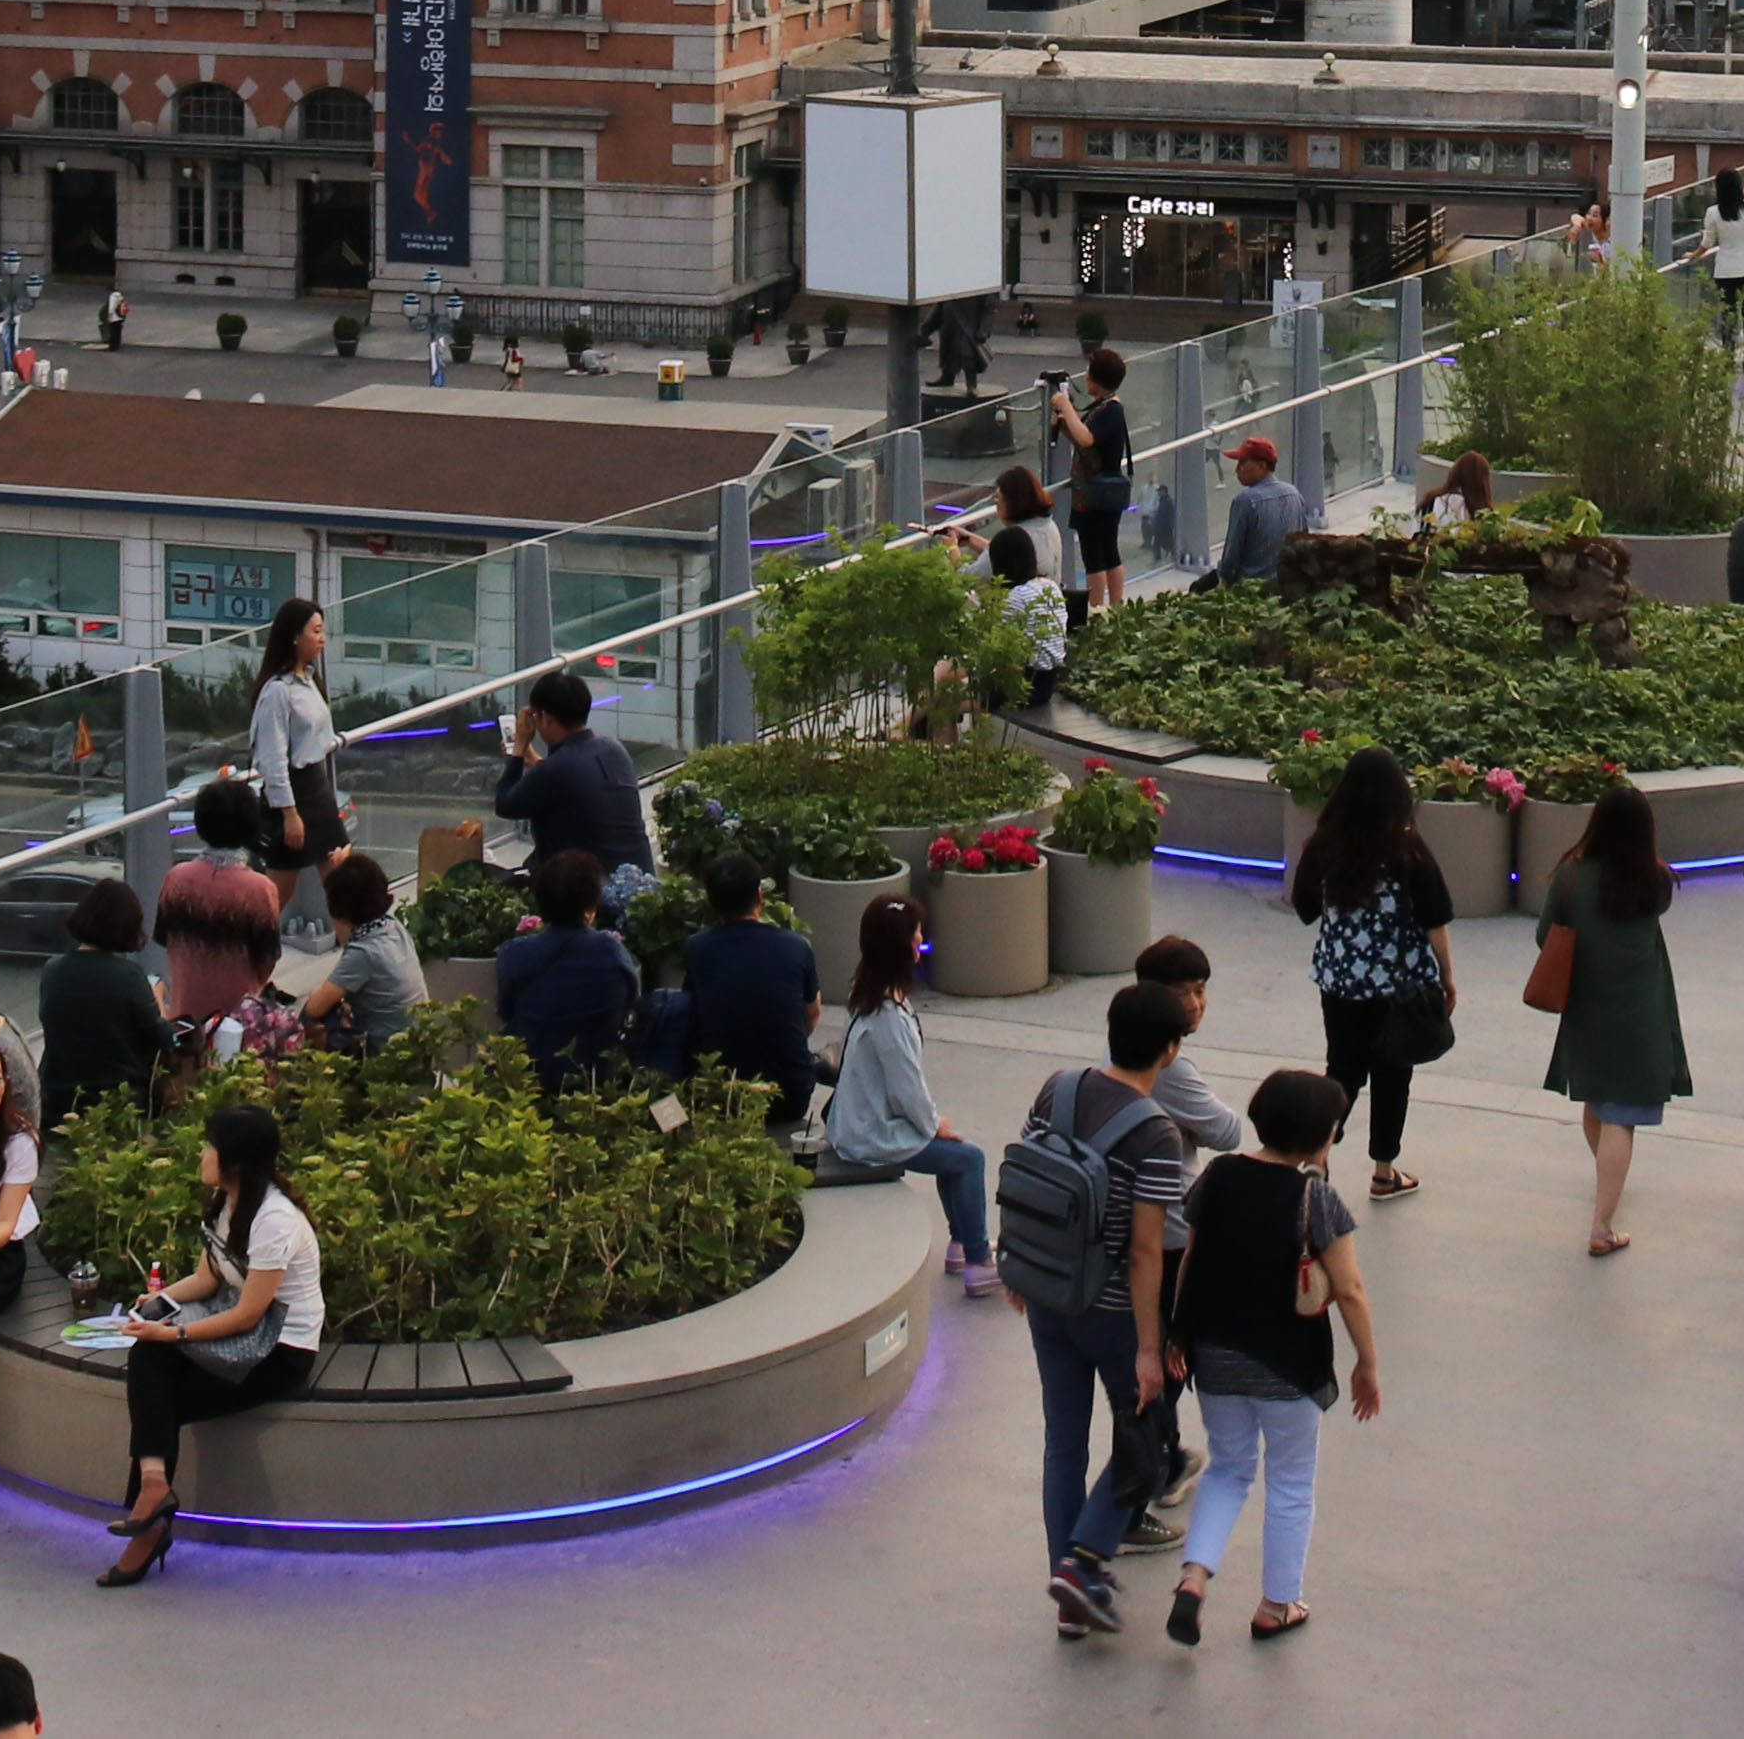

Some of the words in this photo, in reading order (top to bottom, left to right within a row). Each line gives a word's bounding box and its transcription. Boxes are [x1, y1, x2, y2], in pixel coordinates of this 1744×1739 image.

[1127, 195, 1174, 215] Cafe
[1175, 200, 1215, 217] 자리
[230, 566, 263, 589] A형
[171, 572, 215, 607] 급구
[230, 595, 264, 619] O형
